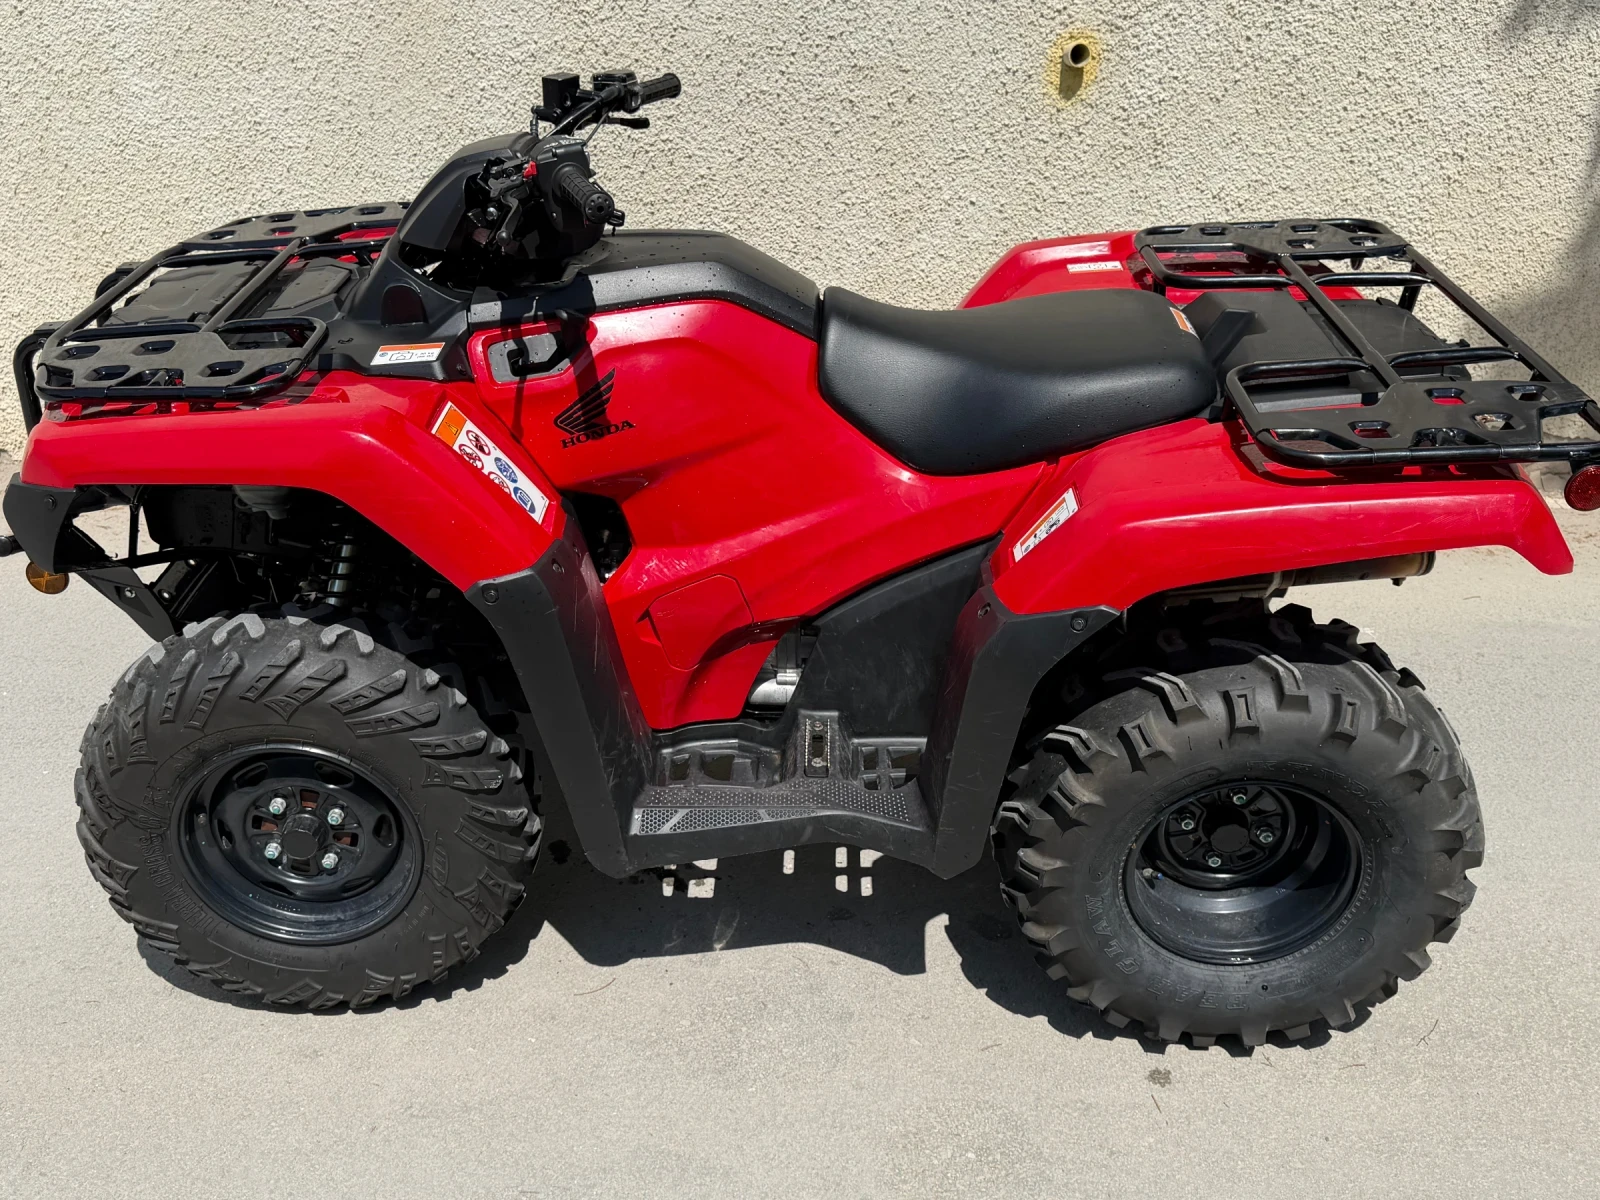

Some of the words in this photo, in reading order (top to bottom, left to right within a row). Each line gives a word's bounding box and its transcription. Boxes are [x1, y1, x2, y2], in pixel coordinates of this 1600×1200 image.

[561, 419, 635, 448] HONDA
[1084, 894, 1140, 975] CLAW
[1146, 976, 1251, 1011] BEAR
